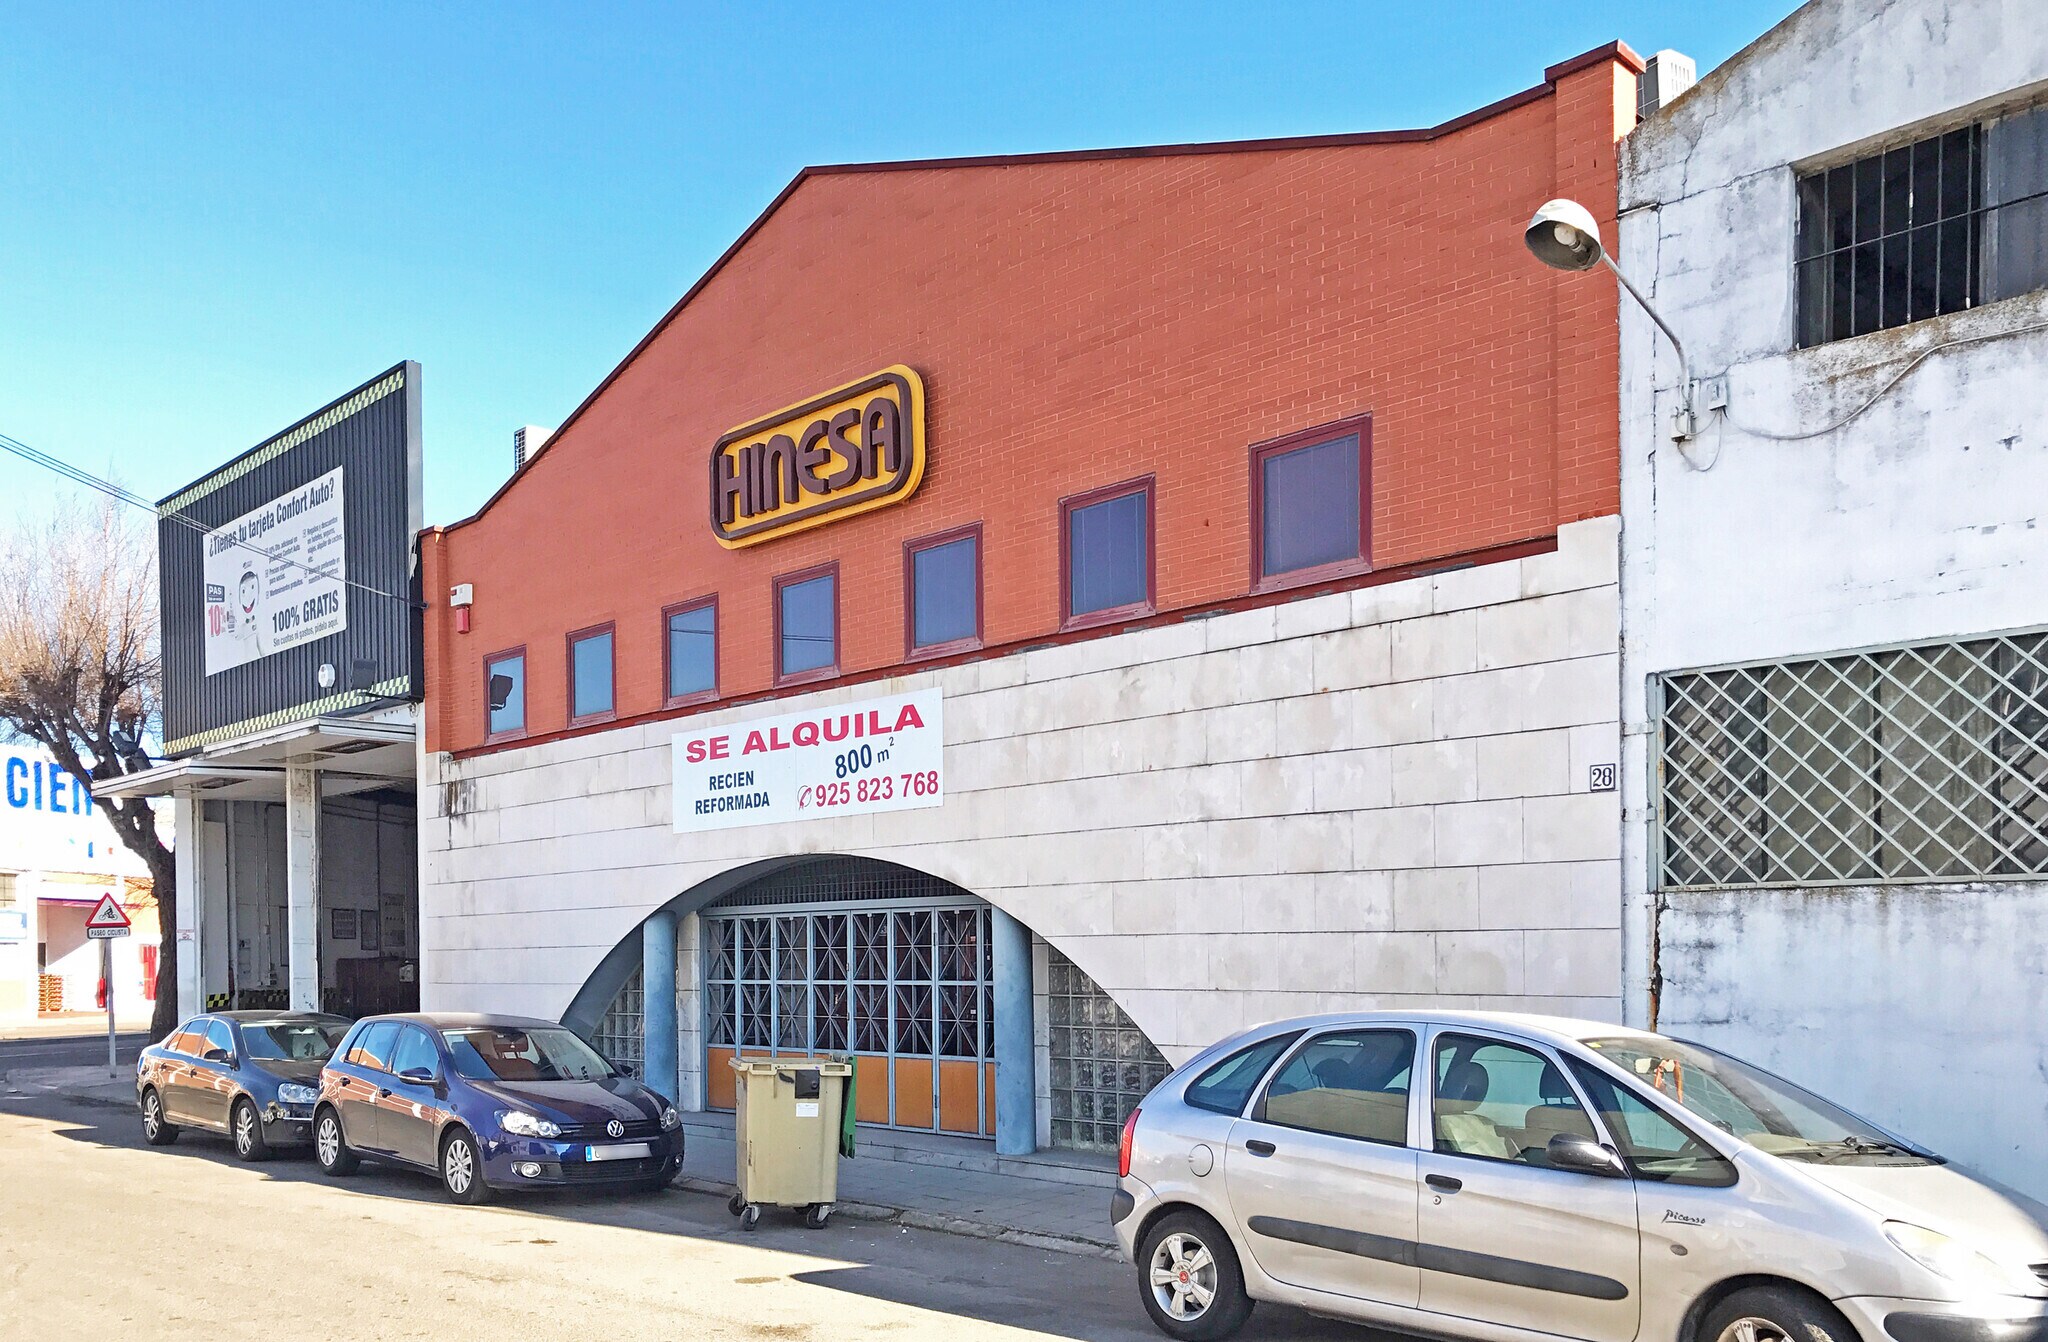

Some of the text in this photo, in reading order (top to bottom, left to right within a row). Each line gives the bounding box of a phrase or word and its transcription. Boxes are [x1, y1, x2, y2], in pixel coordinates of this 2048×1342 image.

[718, 397, 900, 525] HINESA
[239, 523, 247, 543] tu
[249, 511, 275, 538] tarjeta
[276, 491, 308, 525] Confort
[309, 476, 335, 510] Auto?
[208, 586, 222, 595] PAS
[272, 589, 339, 634] 100% GRATIS
[686, 704, 925, 763] SE ALQUILA
[835, 743, 873, 779] 800
[709, 770, 754, 791] RECIEN
[816, 770, 939, 808] 925 823 768
[1592, 767, 1612, 787] 28
[695, 791, 770, 815] REFORMADA
[90, 929, 106, 937] PASEO
[1661, 1209, 1706, 1225] Picasso
